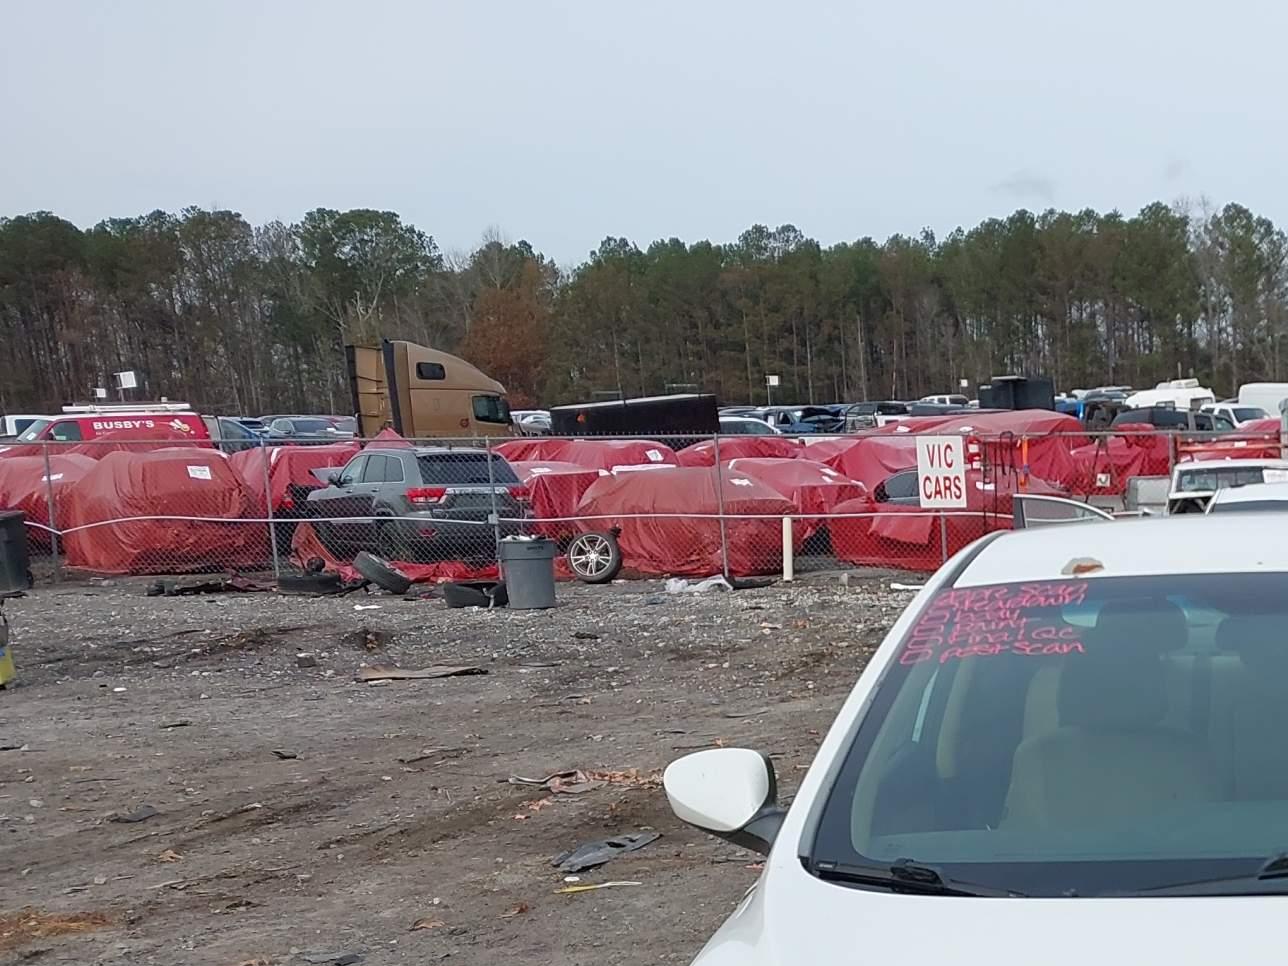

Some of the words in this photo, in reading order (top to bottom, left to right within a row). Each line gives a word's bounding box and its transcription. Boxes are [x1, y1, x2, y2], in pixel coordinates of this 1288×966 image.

[93, 419, 155, 430] BUSBY'S
[926, 443, 954, 468] VIC
[923, 475, 962, 500] CARS
